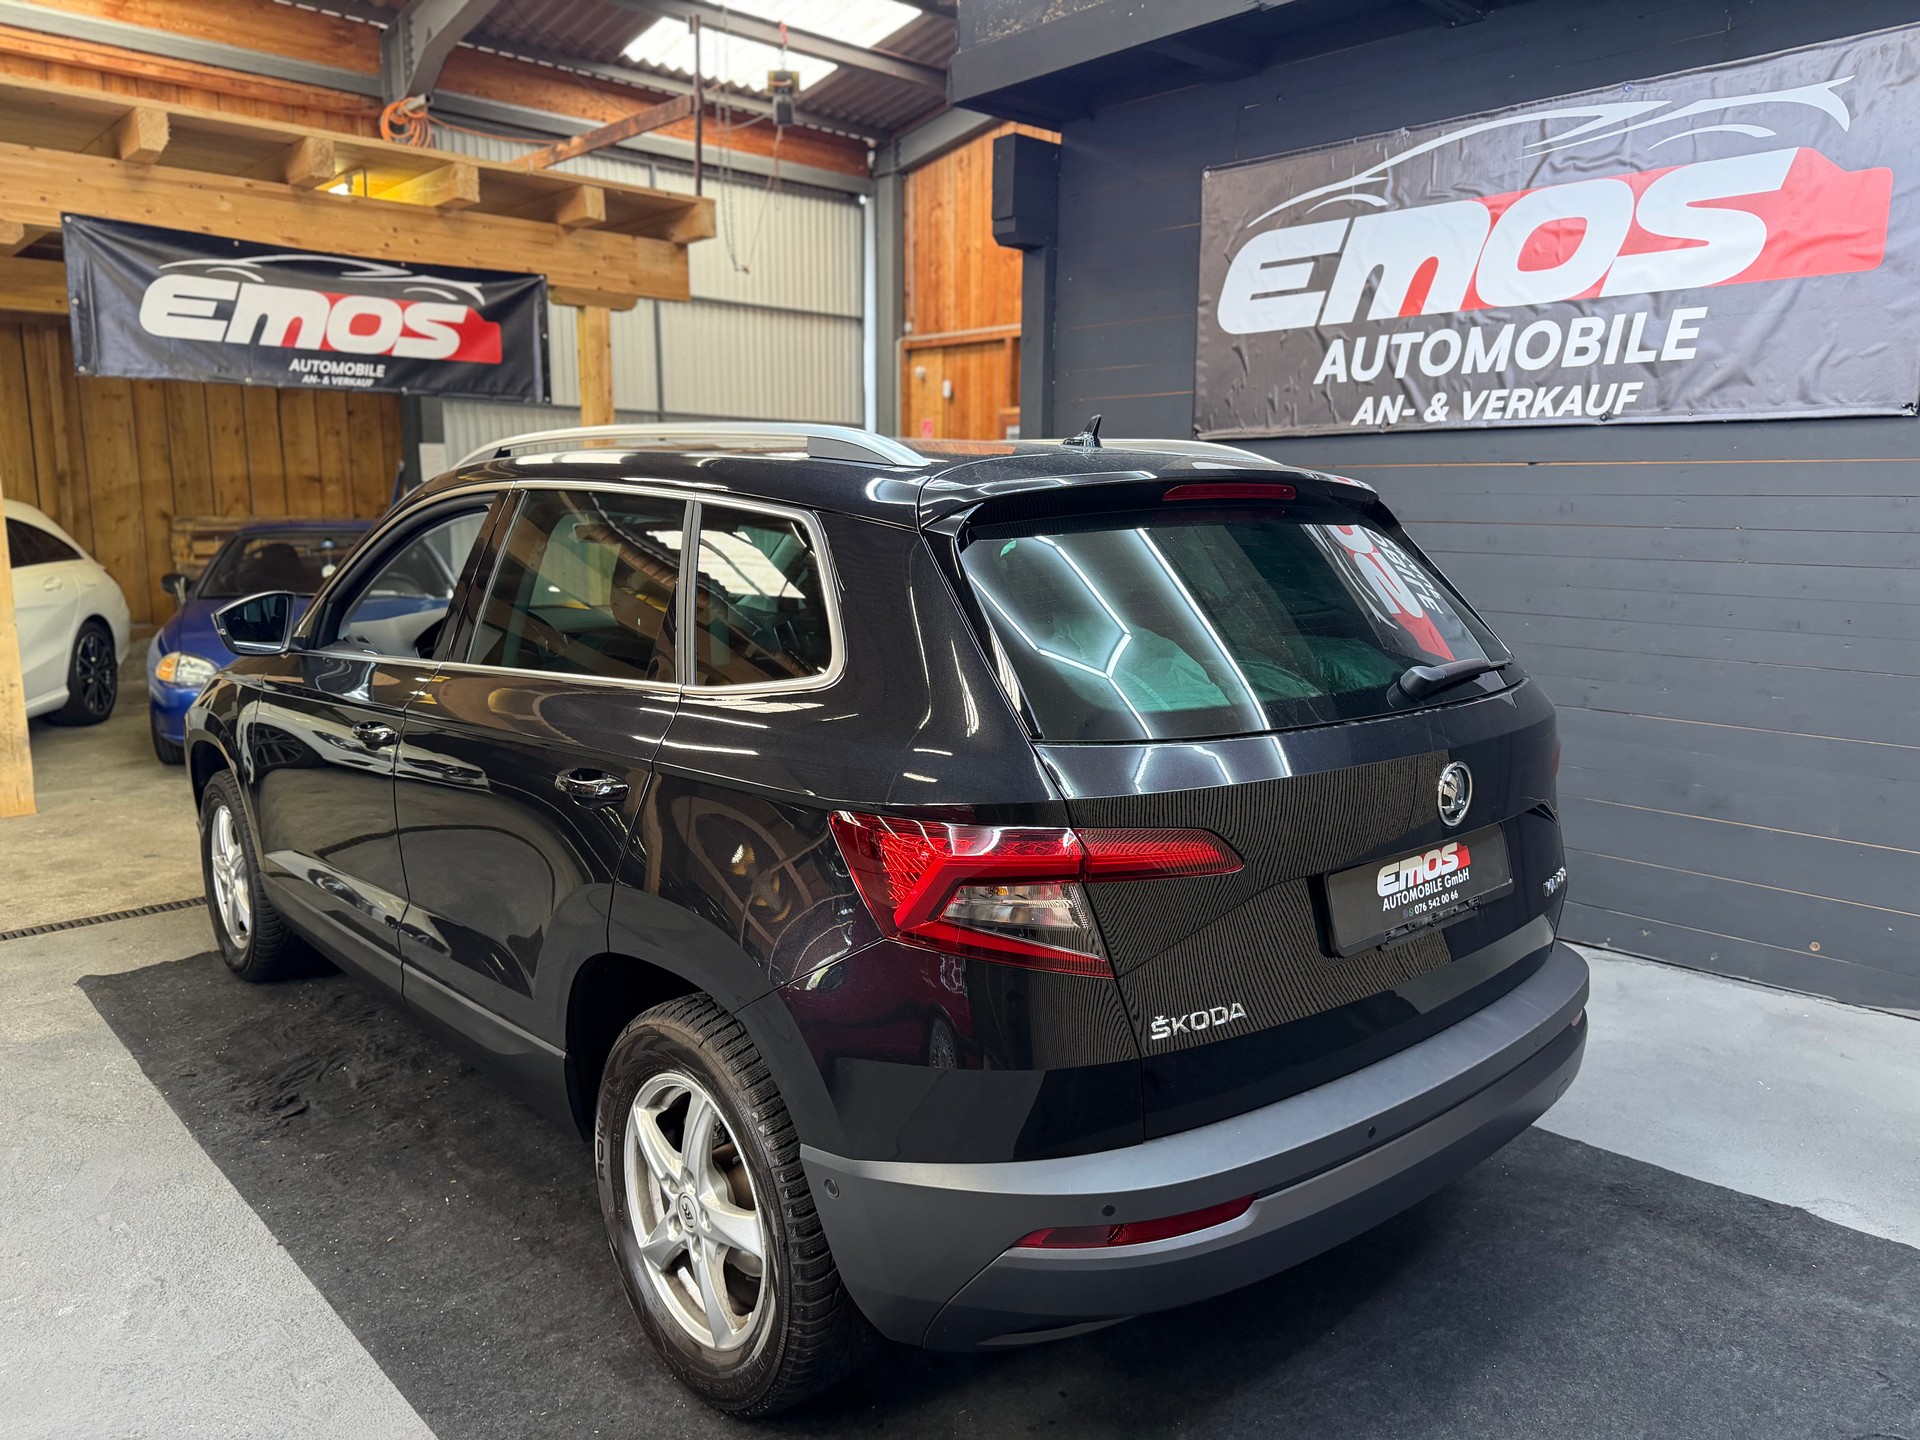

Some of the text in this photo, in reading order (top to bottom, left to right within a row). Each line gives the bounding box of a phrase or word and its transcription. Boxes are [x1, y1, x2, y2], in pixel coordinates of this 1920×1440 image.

[1313, 307, 1708, 385] AUTOMOBILE
[288, 358, 386, 378] AUTOMOBILE
[331, 376, 375, 388] VERKAUF
[1351, 382, 1643, 426] AN- & VERKAUF
[1382, 867, 1470, 912] AUTOMOBILE GmbH
[1414, 889, 1459, 915] 076 542 00 66
[1151, 1002, 1247, 1040] ŠKODA
